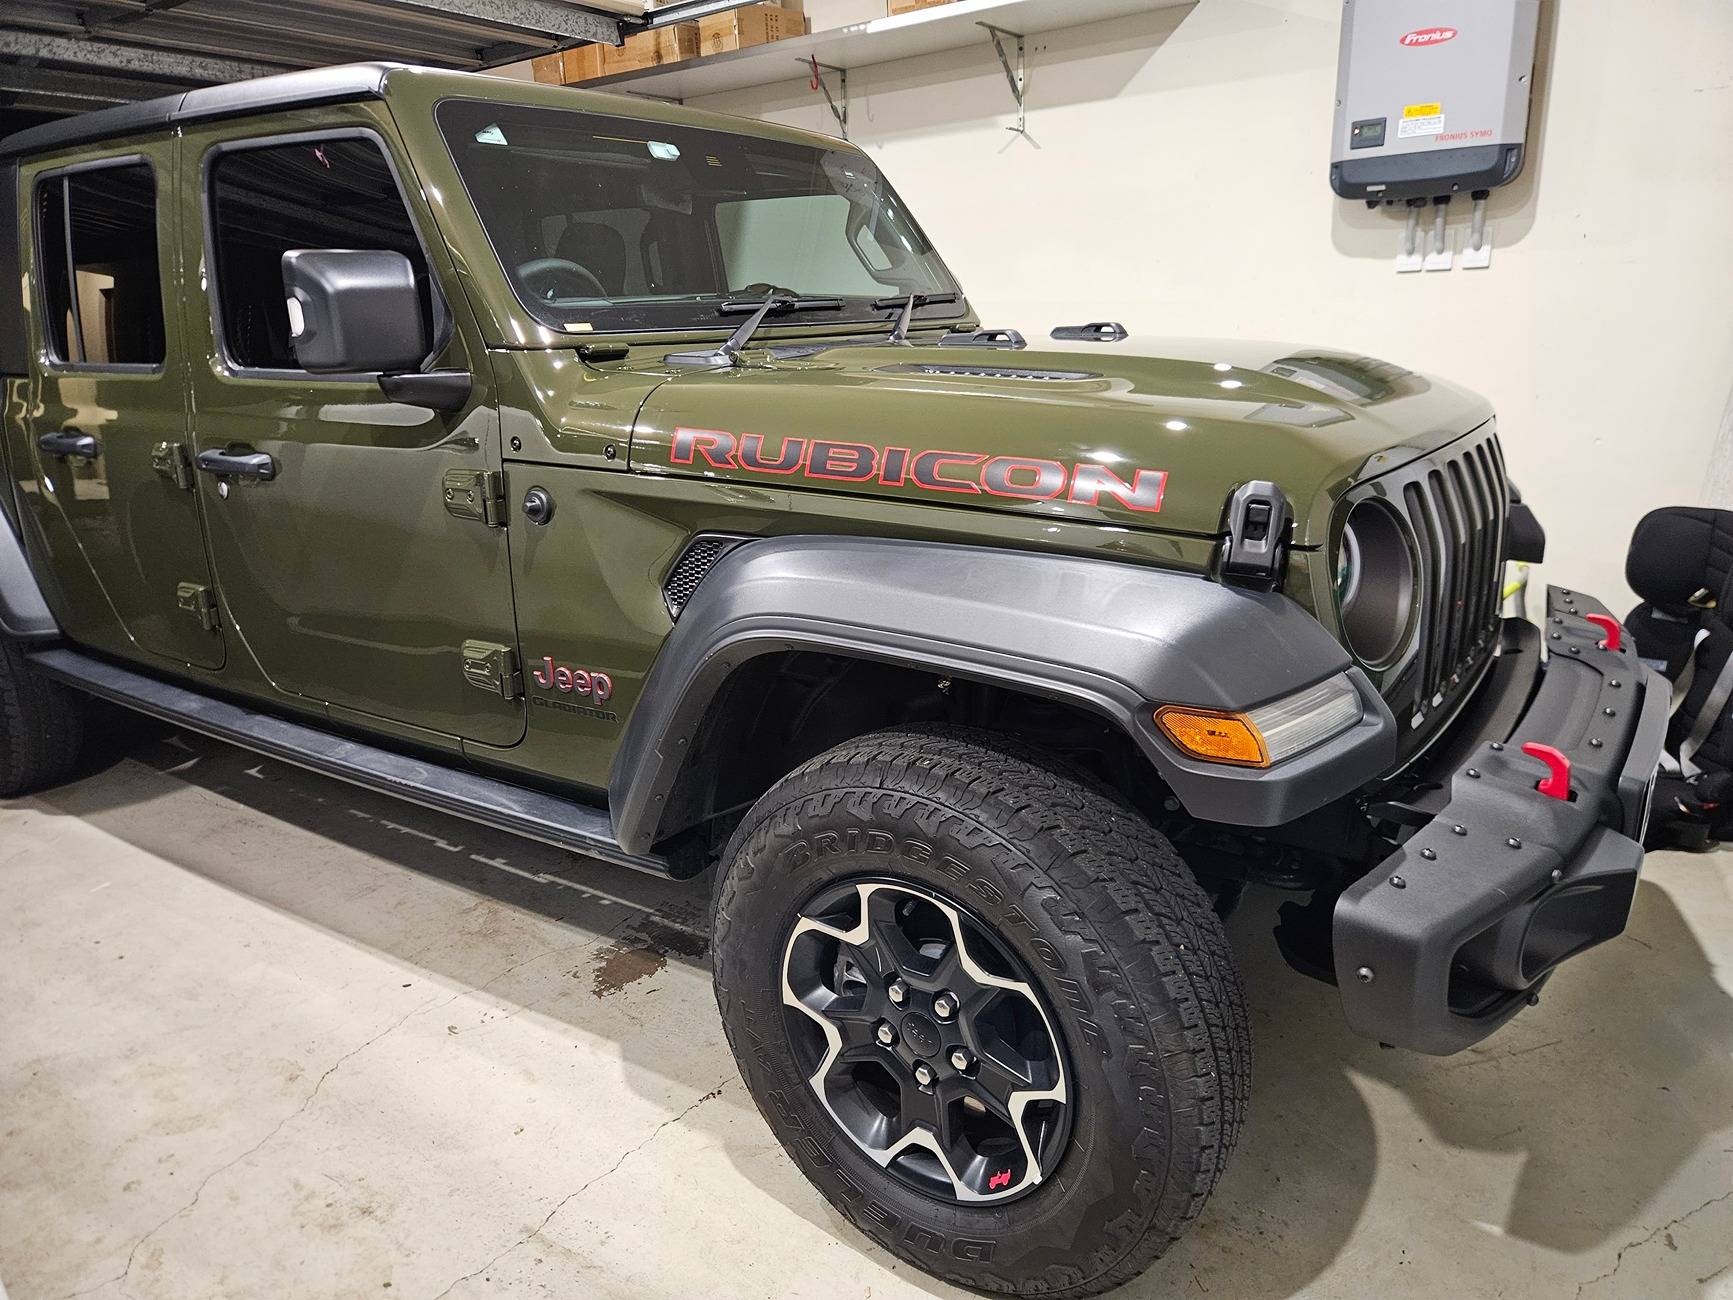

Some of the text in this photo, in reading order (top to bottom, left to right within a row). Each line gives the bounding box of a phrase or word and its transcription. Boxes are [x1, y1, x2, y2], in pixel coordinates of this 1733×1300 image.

[1404, 30, 1455, 44] Fronius
[1434, 128, 1493, 142] FRONIUS SYMO
[670, 427, 1168, 512] RUBICON
[533, 656, 613, 706] Jeep
[784, 828, 1100, 1050] BRIDGESTONE
[767, 1089, 998, 1263] DUELER
